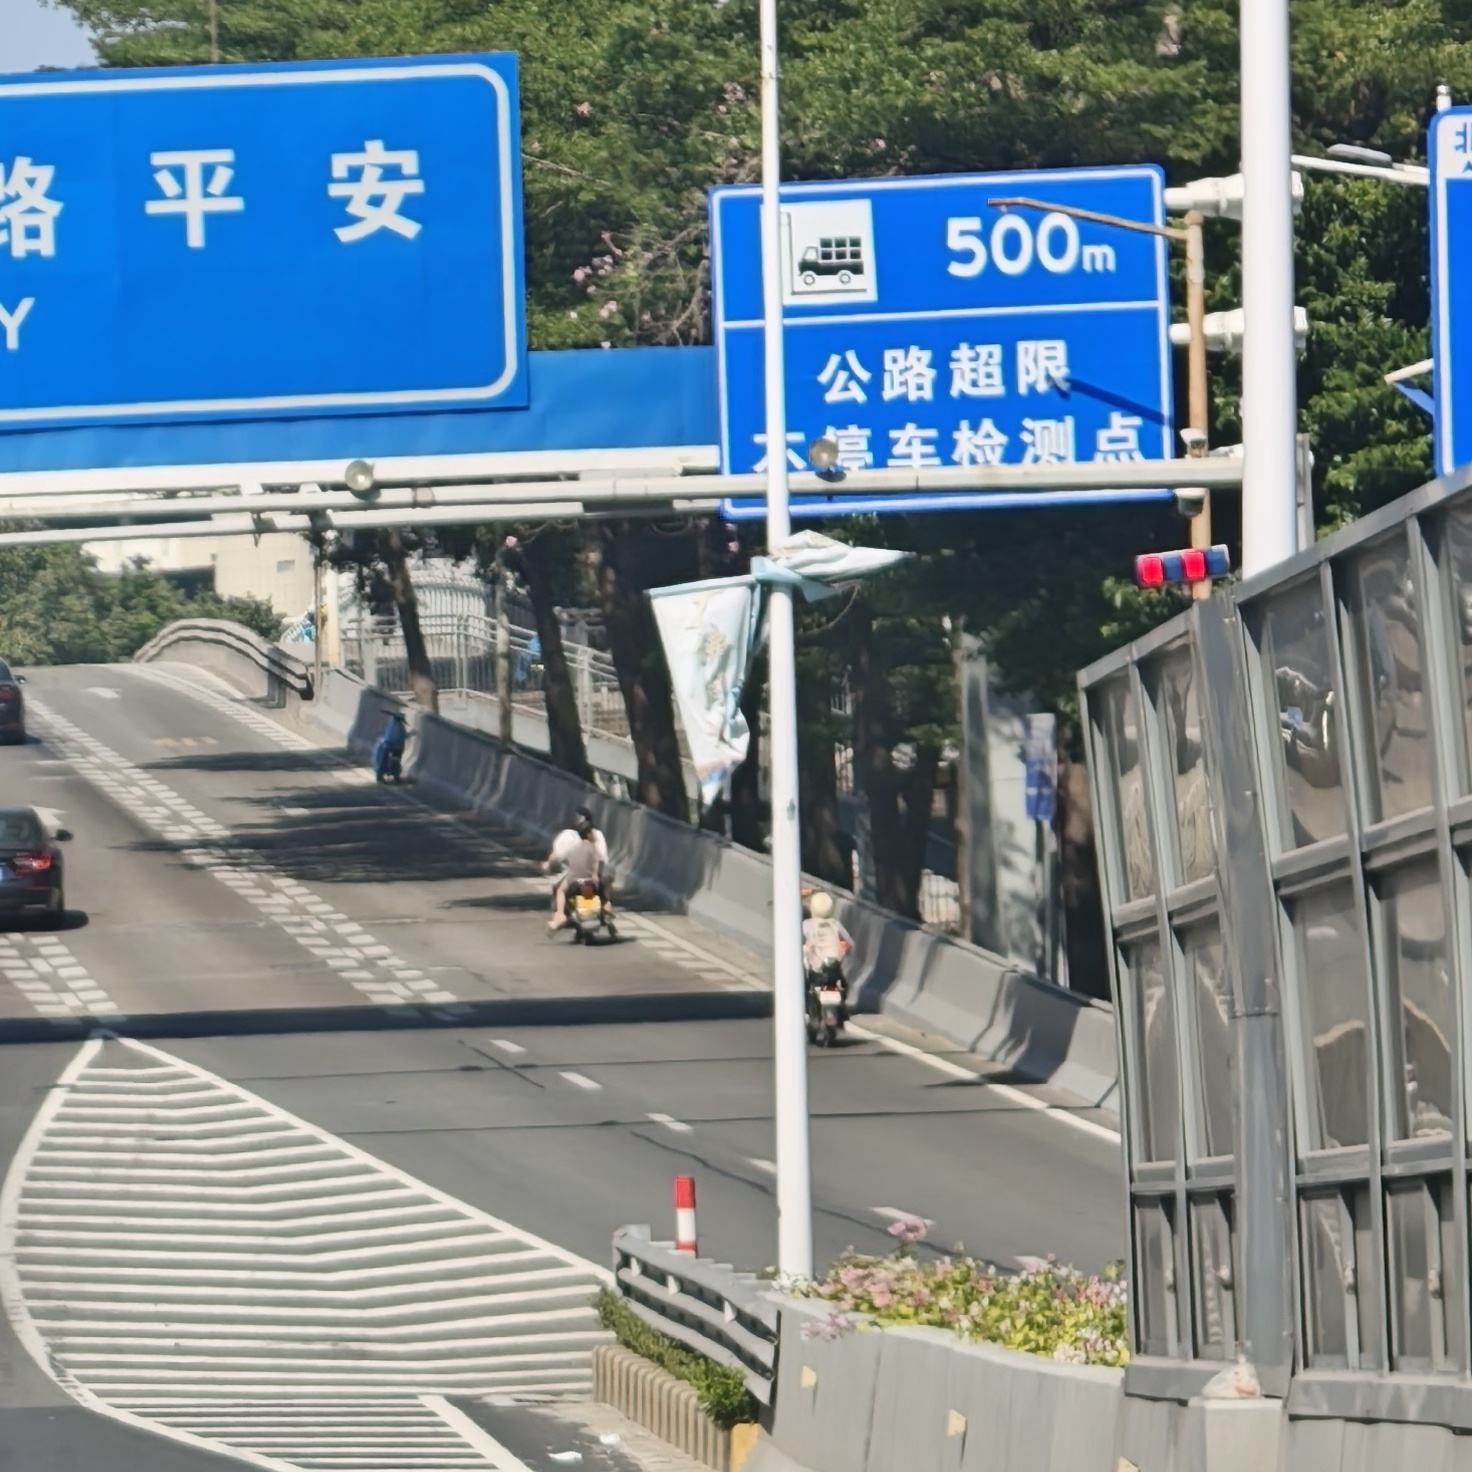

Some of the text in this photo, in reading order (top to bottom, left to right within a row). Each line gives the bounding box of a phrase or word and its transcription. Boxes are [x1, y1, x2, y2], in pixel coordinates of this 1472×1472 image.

[946, 211, 1117, 278] 500m
[817, 339, 1071, 405] 公路超限
